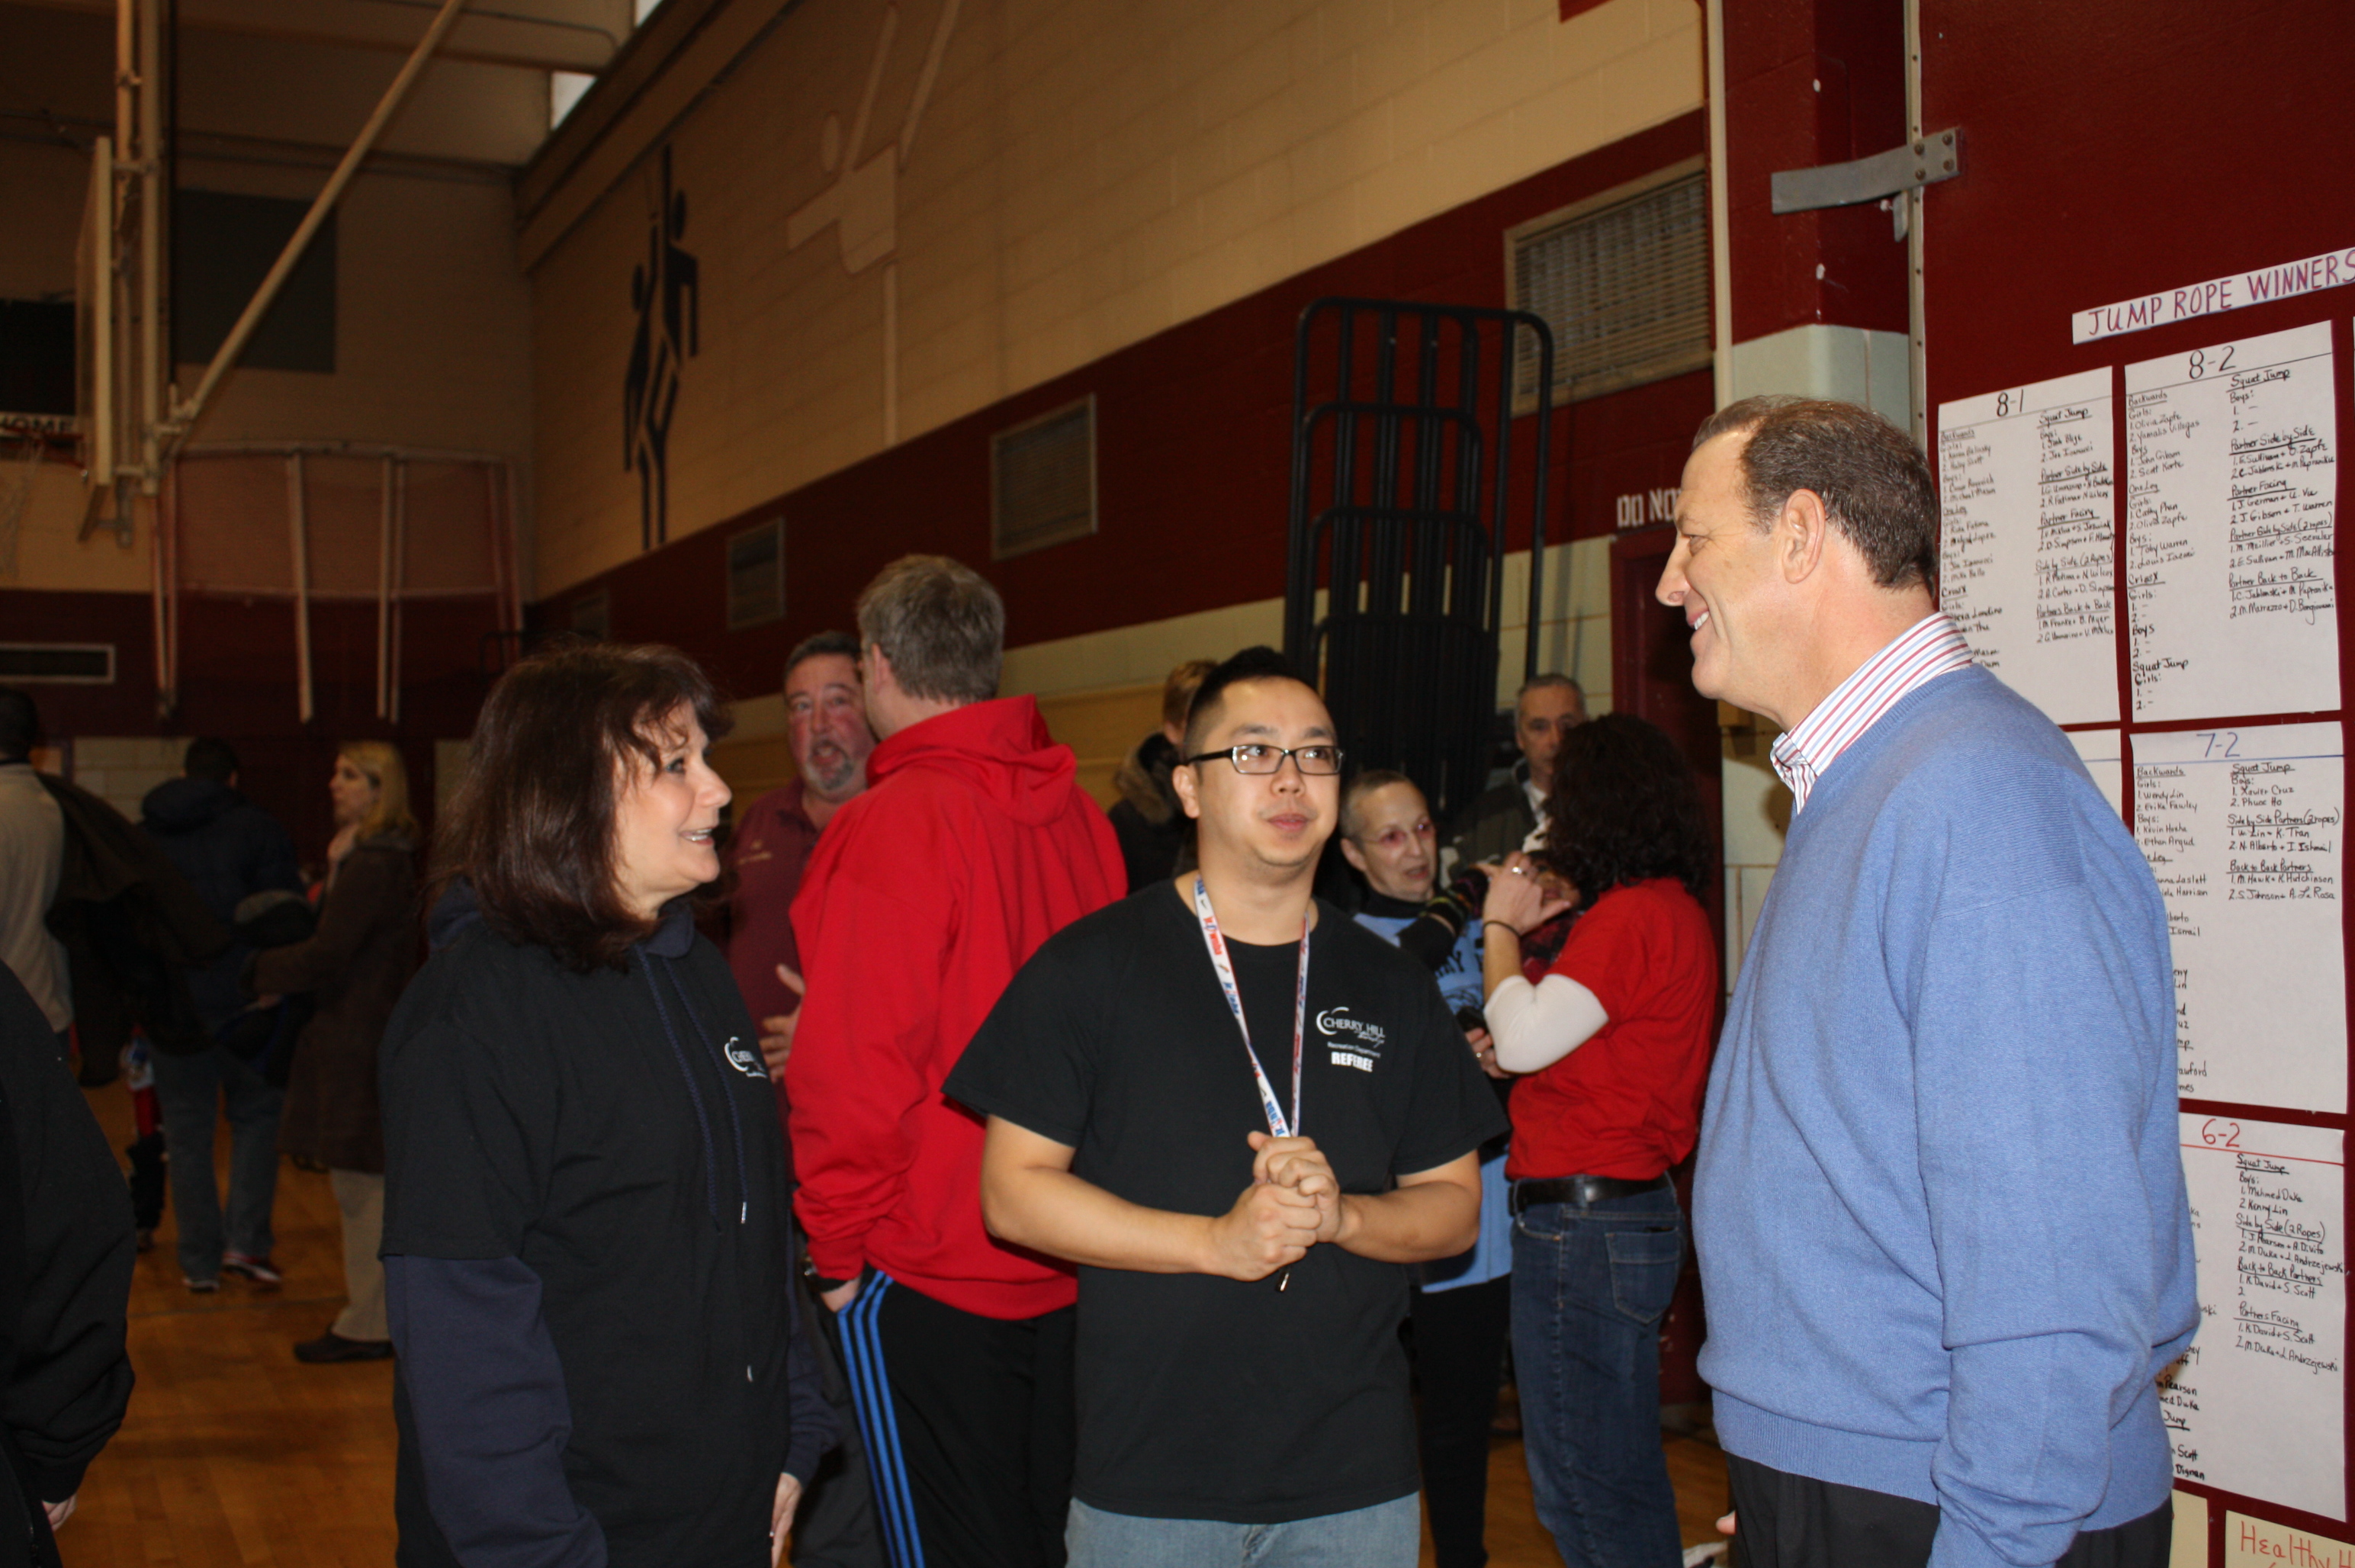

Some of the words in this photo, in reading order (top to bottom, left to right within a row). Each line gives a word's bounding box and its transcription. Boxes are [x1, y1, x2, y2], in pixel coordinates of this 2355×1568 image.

[2088, 297, 2161, 334] JUMP
[2174, 279, 2232, 318] ROPE
[2247, 250, 2355, 301] WINNERS
[2189, 345, 2236, 379] 8-2
[2231, 372, 2260, 390] Squat
[2263, 369, 2290, 384] Jump
[1997, 389, 2023, 417] 8-1
[2128, 390, 2167, 407] Backwards
[1617, 493, 1645, 529] DO
[1648, 487, 1682, 522] NO
[2196, 732, 2240, 757] 7-2
[2137, 765, 2185, 776] Backwards
[2232, 763, 2260, 778] Squat
[2262, 762, 2291, 774] Jump
[2271, 785, 2295, 795] Cruz
[2286, 825, 2309, 839] Tran
[2230, 859, 2249, 872] Back
[2260, 859, 2278, 872] Back
[1323, 1017, 1364, 1033] CHERRY
[1366, 1023, 1385, 1036] HILL
[1331, 1051, 1373, 1072] REFEREE
[2202, 1118, 2240, 1147] 6-2
[2237, 1153, 2260, 1171] Squat
[2263, 1159, 2286, 1174] Jump
[2267, 1261, 2287, 1278] Back
[2293, 1285, 2315, 1300] Scott
[2293, 1331, 2316, 1345] Scott
[2177, 1444, 2199, 1462] Scott
